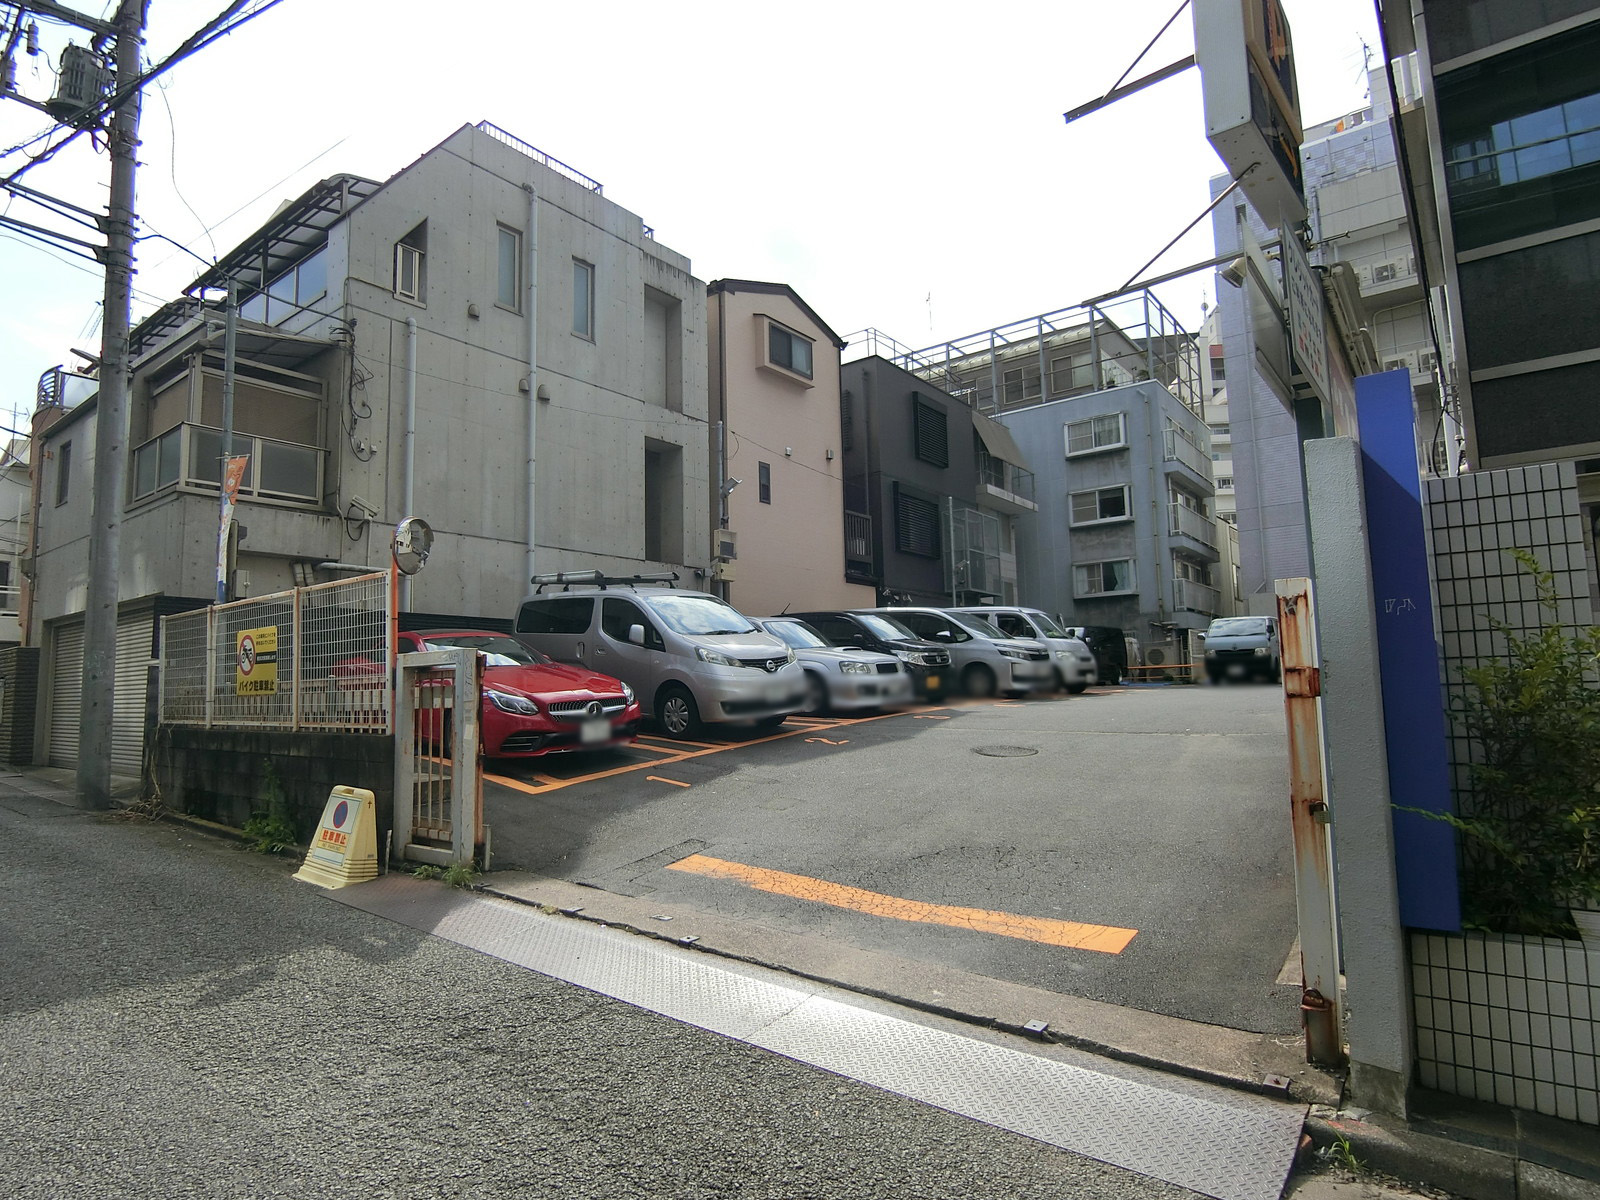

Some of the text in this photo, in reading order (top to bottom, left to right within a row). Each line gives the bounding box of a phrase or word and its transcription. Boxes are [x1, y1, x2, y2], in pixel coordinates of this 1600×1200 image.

[238, 679, 275, 692] バイク駐車禁止
[322, 829, 347, 845] 駐車禁止
